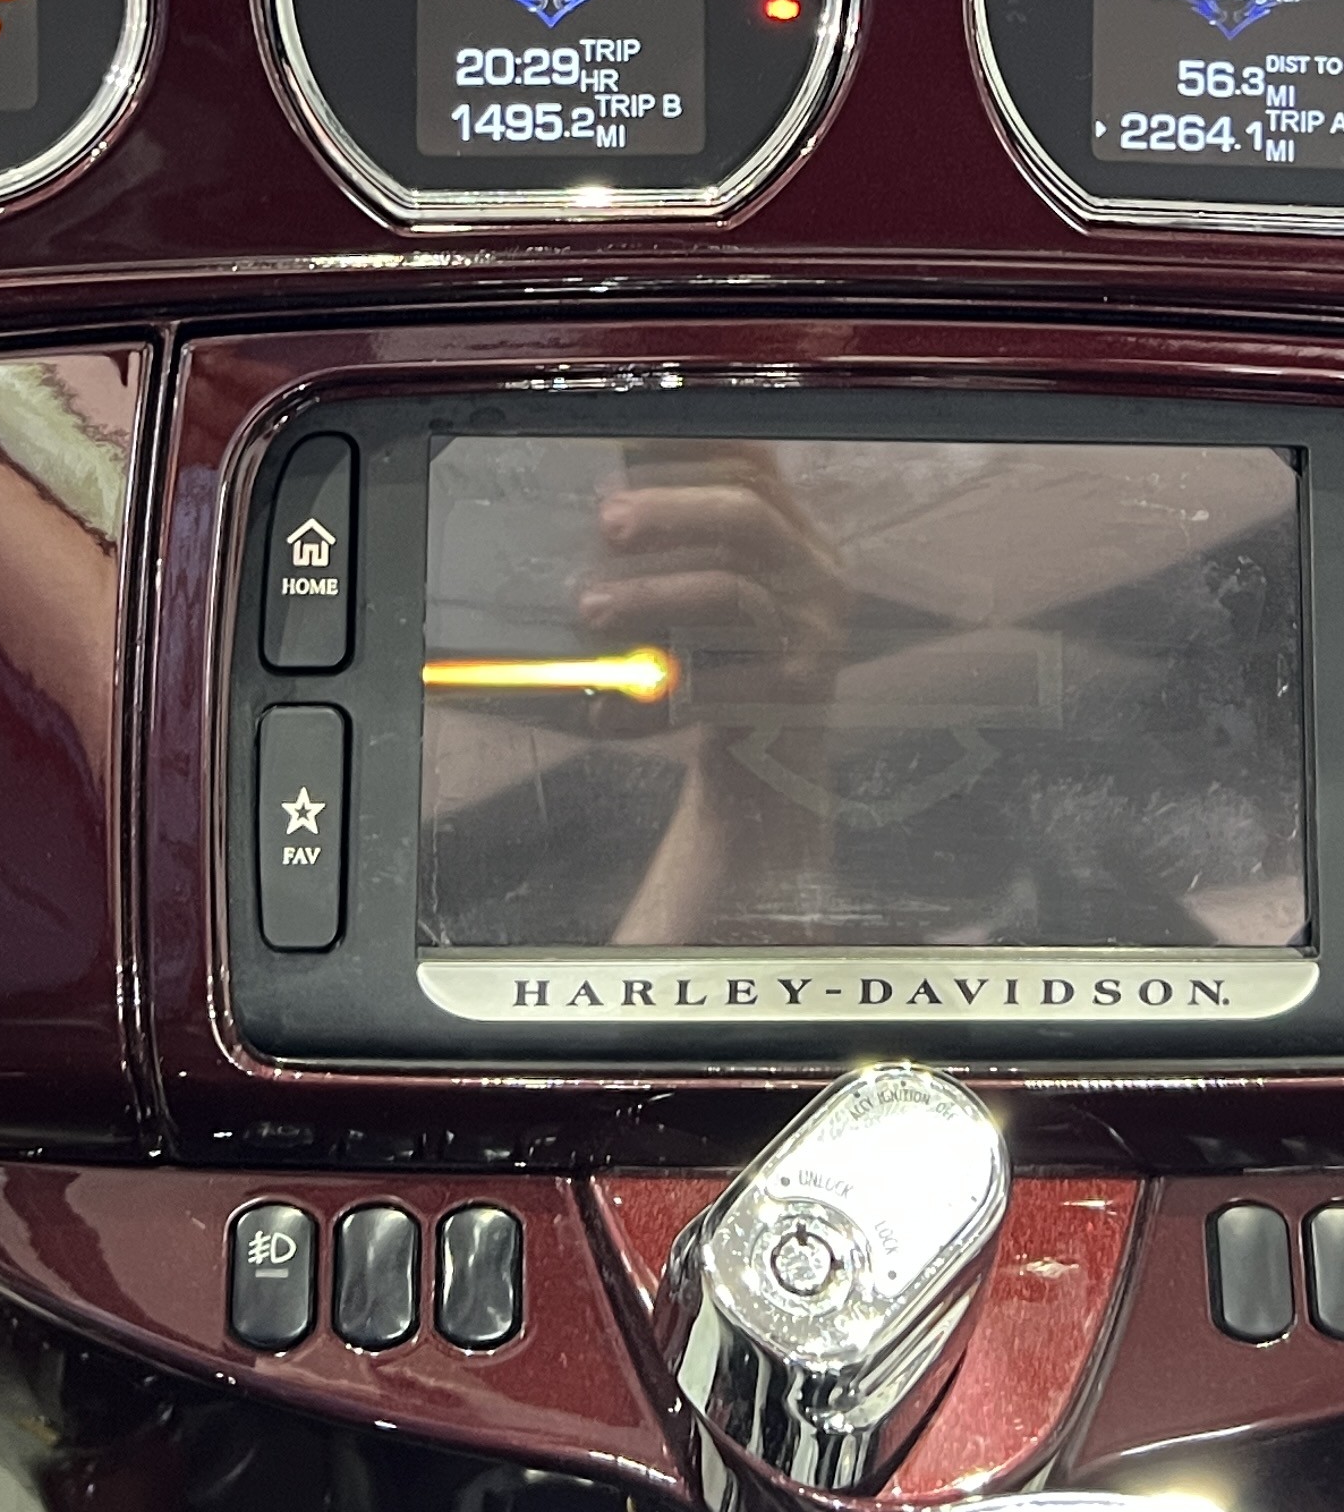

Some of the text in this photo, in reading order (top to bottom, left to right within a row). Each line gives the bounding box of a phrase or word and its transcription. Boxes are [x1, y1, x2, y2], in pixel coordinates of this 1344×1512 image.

[456, 39, 641, 86] 20:29 TRIP
[580, 69, 619, 92] HR
[1177, 59, 1265, 98] 56.3
[1265, 55, 1311, 74] DIST
[1314, 56, 1343, 75] TO
[1266, 85, 1296, 107] MI
[451, 94, 683, 142] 1495.2 TRIP B
[596, 124, 626, 148] MI
[1120, 112, 1263, 152] 2264.1
[1265, 109, 1325, 133] TRIP
[1266, 140, 1295, 162] MI
[282, 578, 338, 595] HOME
[282, 847, 321, 865] FAV
[877, 1088, 931, 1105] IGNITION
[799, 1170, 853, 1198] UNLOCK
[874, 1220, 899, 1255] LOCK
